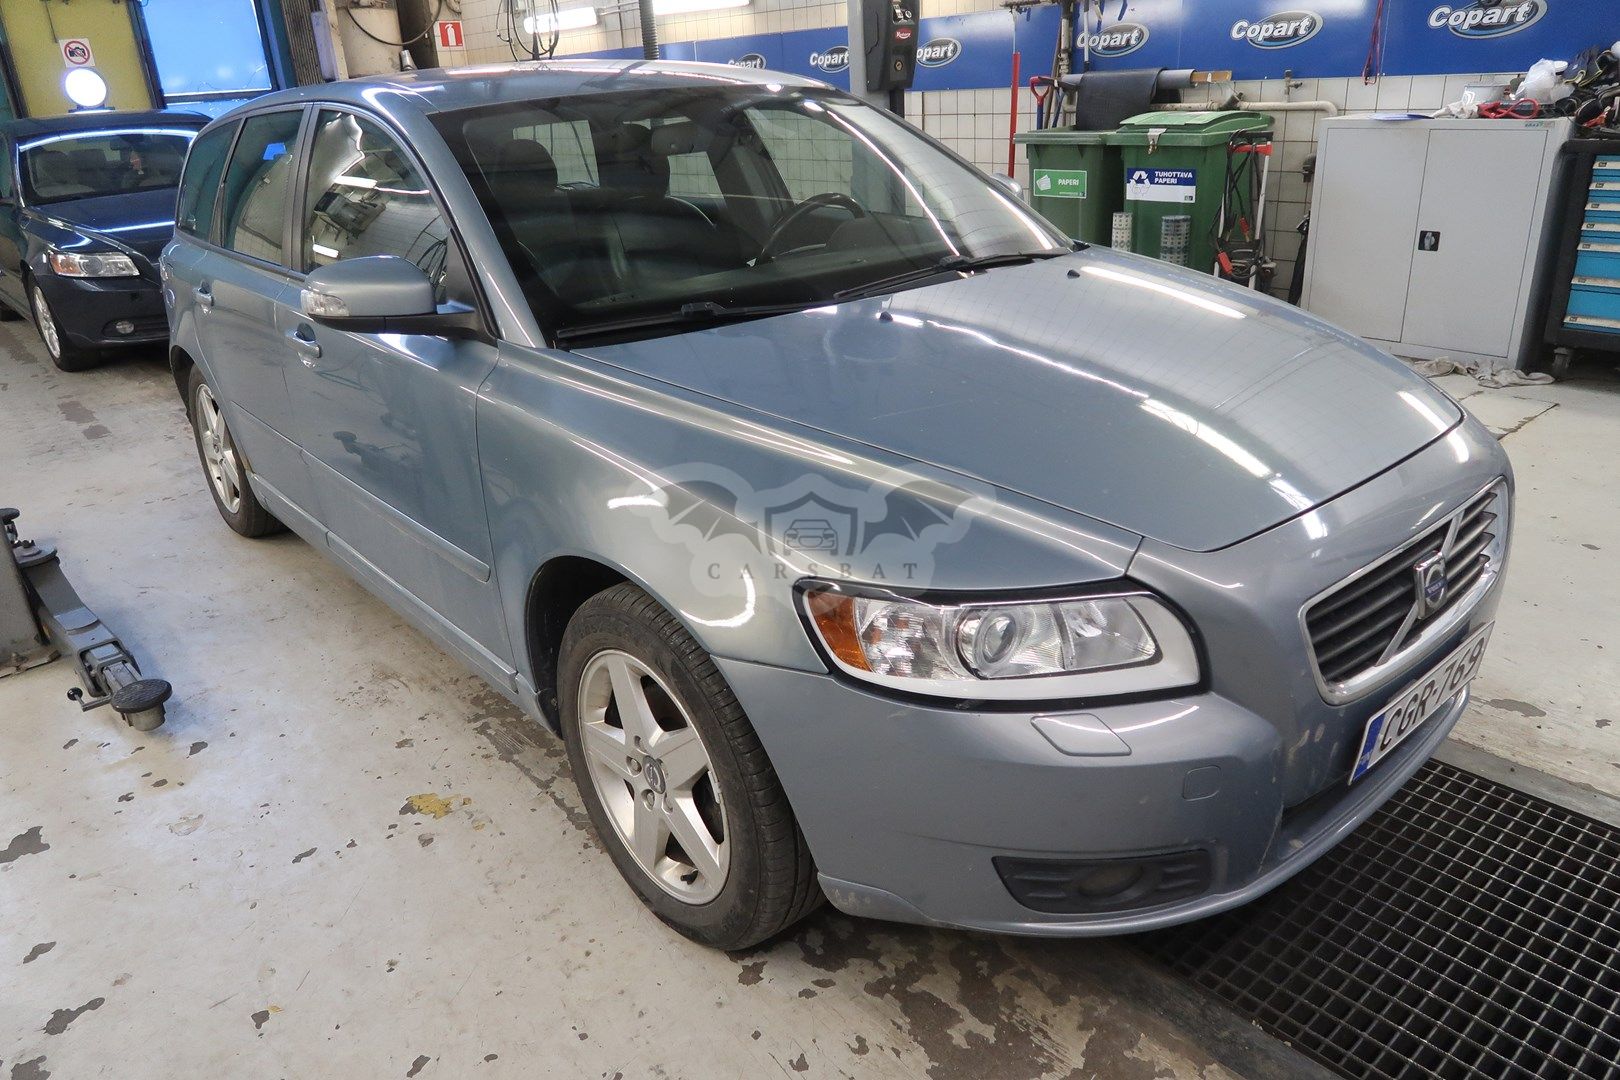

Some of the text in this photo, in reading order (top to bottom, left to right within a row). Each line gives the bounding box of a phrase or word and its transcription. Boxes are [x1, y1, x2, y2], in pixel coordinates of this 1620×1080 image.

[1428, 0, 1535, 29] Copart
[1231, 15, 1311, 41] Copart
[810, 50, 849, 67] Copart
[916, 42, 954, 61] opart
[1058, 178, 1080, 186] PAPERI
[1380, 636, 1485, 752] CGR-769
